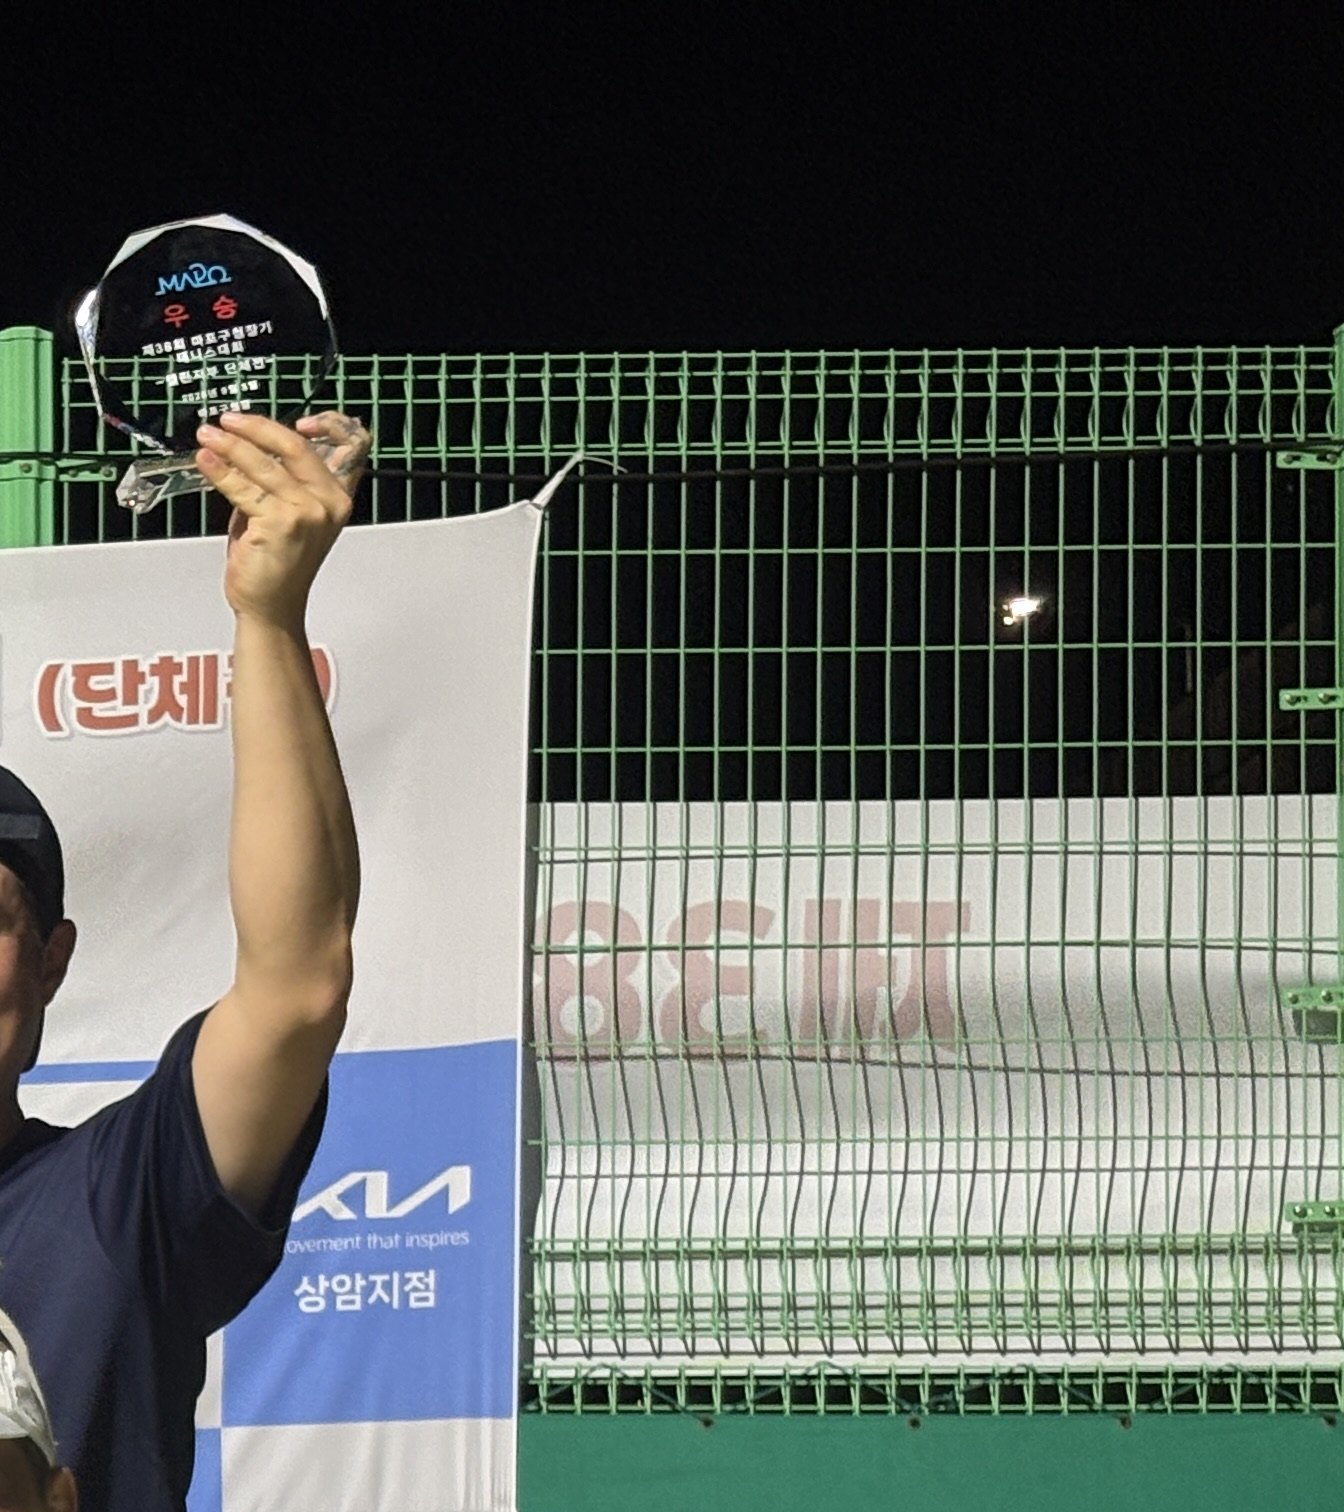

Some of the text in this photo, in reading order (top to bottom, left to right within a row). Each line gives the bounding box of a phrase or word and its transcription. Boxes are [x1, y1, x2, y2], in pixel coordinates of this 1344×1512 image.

[37, 647, 331, 732] (단체)
[366, 1232, 400, 1250] that
[406, 1230, 469, 1252] inspires
[294, 1270, 437, 1312] 상암지점
